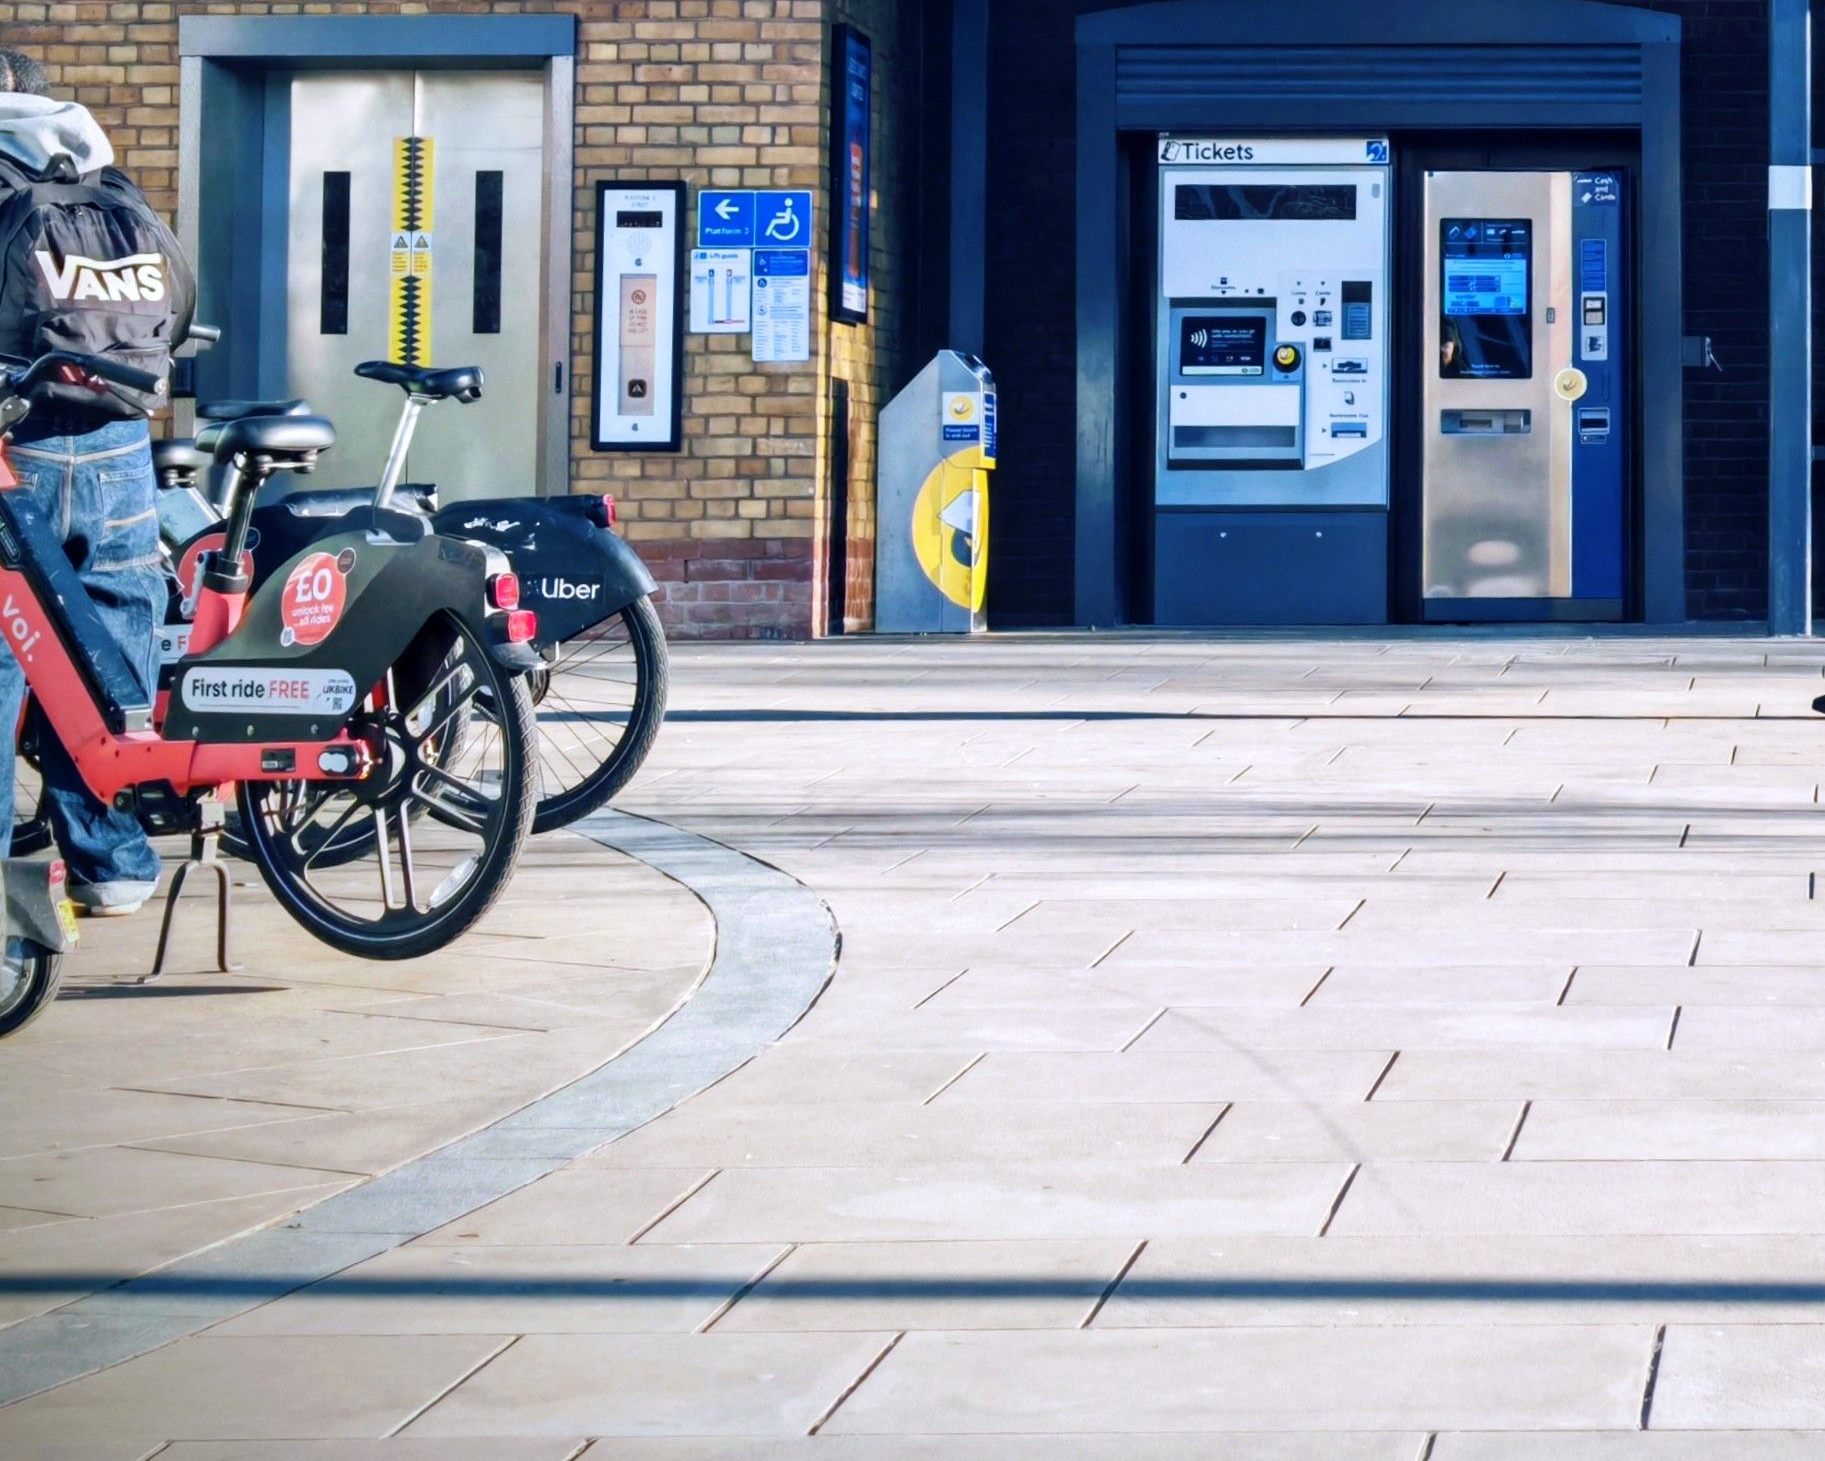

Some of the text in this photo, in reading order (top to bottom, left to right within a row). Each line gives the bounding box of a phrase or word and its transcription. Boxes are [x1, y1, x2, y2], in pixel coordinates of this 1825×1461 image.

[1182, 142, 1253, 160] Tickets
[705, 227, 741, 235] Platform
[35, 250, 165, 302] VANS
[295, 567, 333, 603] £0
[541, 577, 600, 599] Uber
[2, 594, 41, 663] voi.
[192, 678, 309, 700] First ride FREE
[322, 685, 353, 695] UKBIKE
